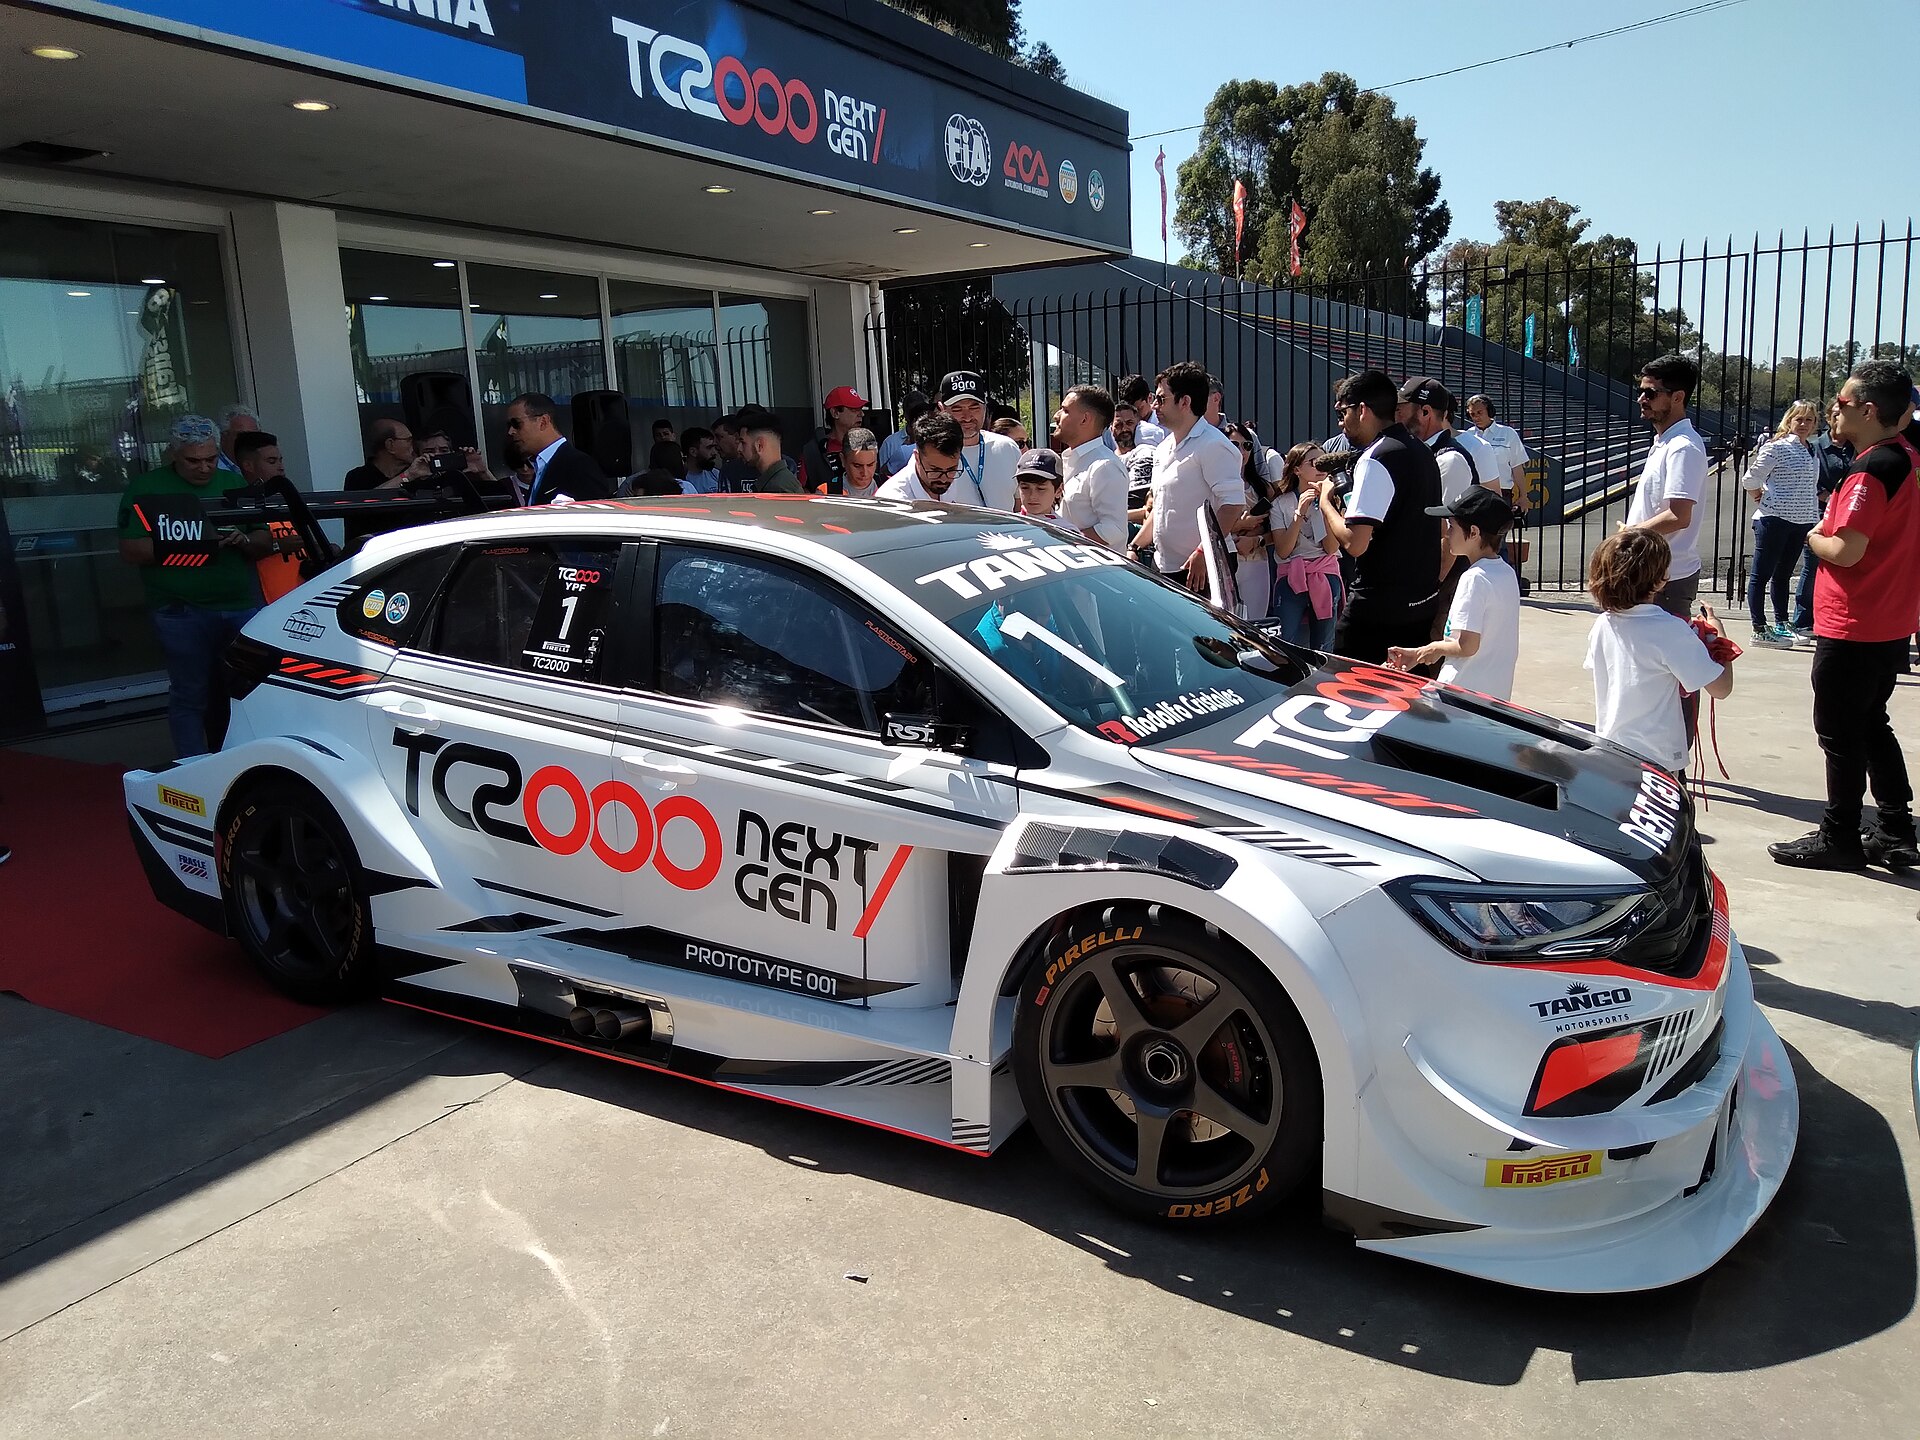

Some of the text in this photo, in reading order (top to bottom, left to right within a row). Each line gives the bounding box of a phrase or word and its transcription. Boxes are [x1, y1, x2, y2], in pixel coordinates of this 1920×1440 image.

[611, 15, 818, 144] TC2000
[824, 88, 877, 133] NEXT
[826, 123, 868, 162] GEN
[951, 379, 977, 392] agro
[158, 513, 203, 542] flow
[558, 566, 601, 583] TC2000
[565, 582, 587, 592] YPF
[913, 543, 1128, 600] TANGO
[558, 596, 578, 640] 1
[532, 656, 570, 673] TC2000
[542, 641, 571, 653] PIRELLI
[999, 611, 1127, 688] 1
[1121, 687, 1245, 737] Rodolfo Cristales
[162, 788, 200, 813] PIRELLI
[392, 726, 724, 891] TC2000
[735, 808, 879, 886] NEXT
[734, 862, 838, 932] GEN
[685, 943, 837, 996] PROTOTYPE 001
[1045, 926, 1143, 985] PIRELLI
[1529, 987, 1632, 1018] TANGO
[1555, 1013, 1630, 1033] MOTORSPORTS
[1226, 1041, 1241, 1084] brembo
[1501, 1153, 1592, 1184] PIRELLI
[1167, 1188, 1253, 1218] ZERO
